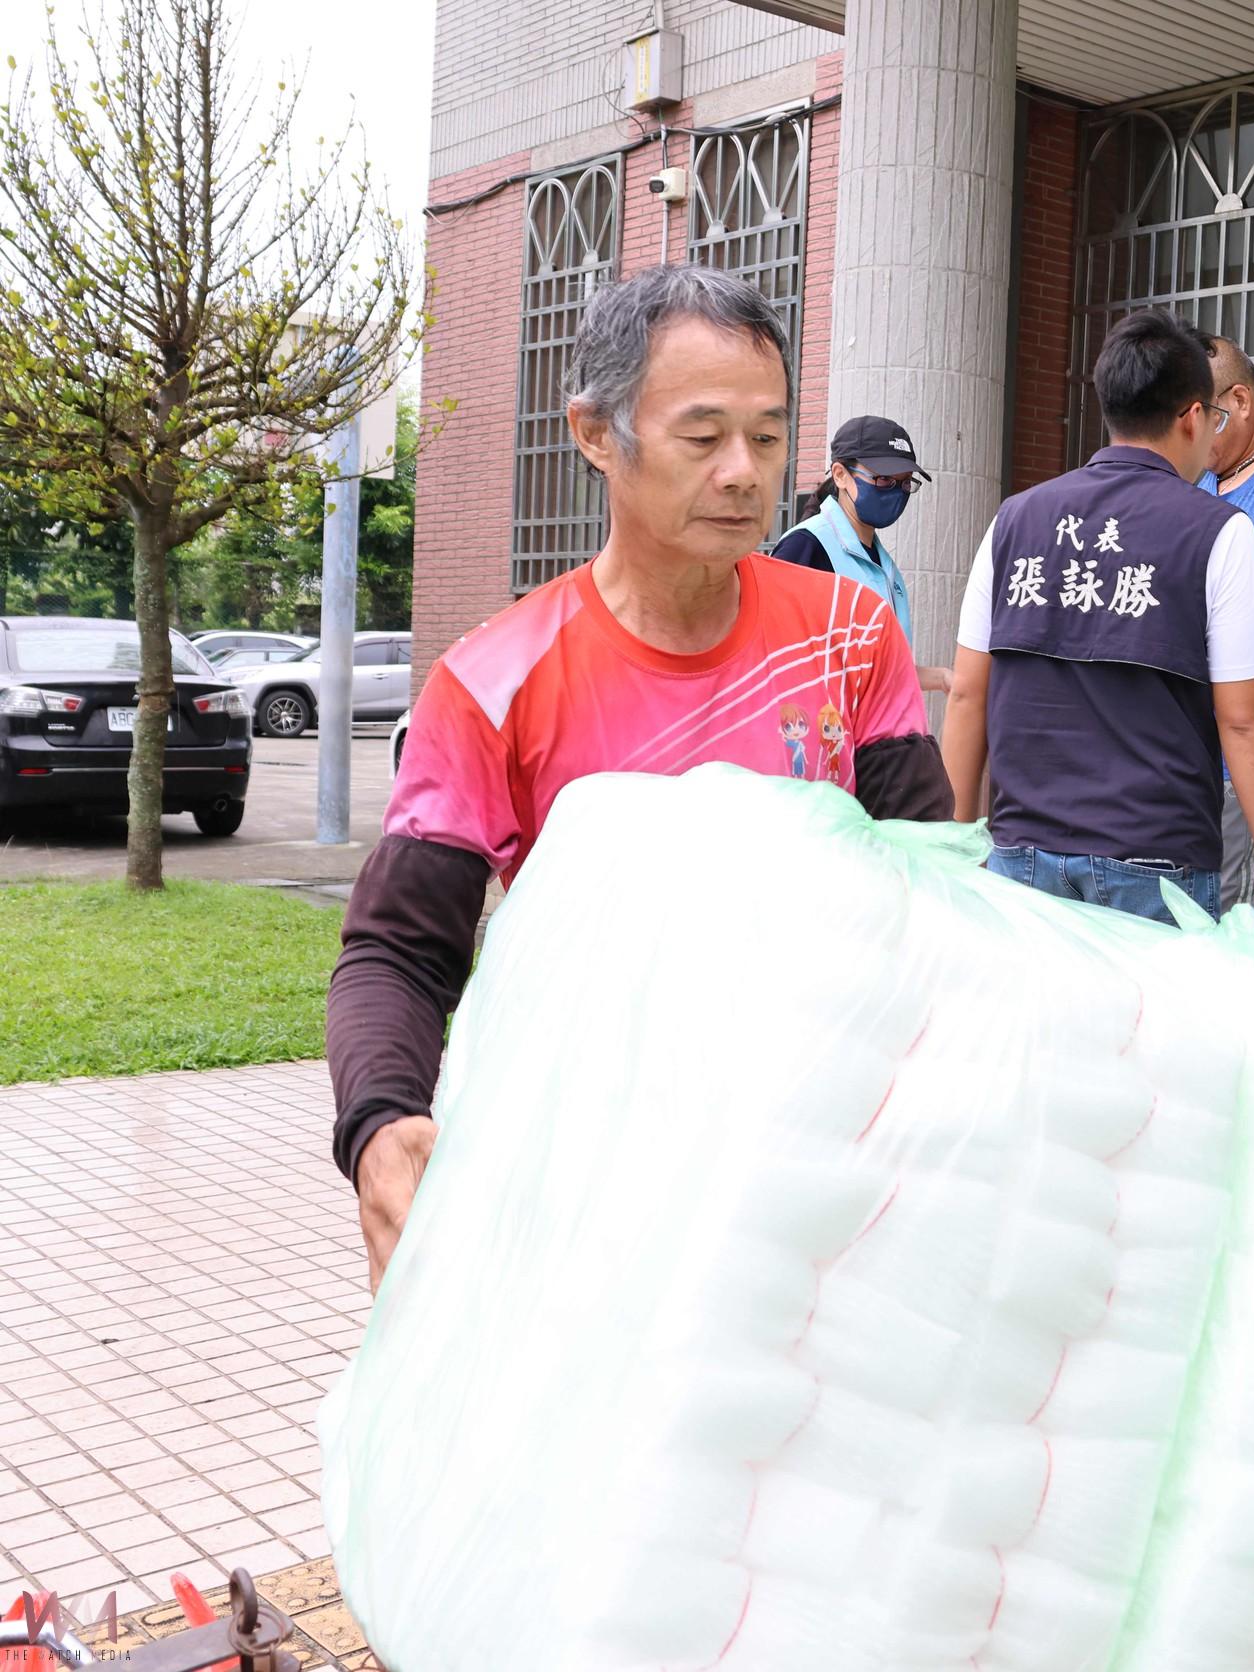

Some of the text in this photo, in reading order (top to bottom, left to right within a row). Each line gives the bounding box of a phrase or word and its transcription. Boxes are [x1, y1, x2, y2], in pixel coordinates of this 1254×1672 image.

[1056, 514, 1124, 553] 代表
[1006, 556, 1161, 618] 張詠勝
